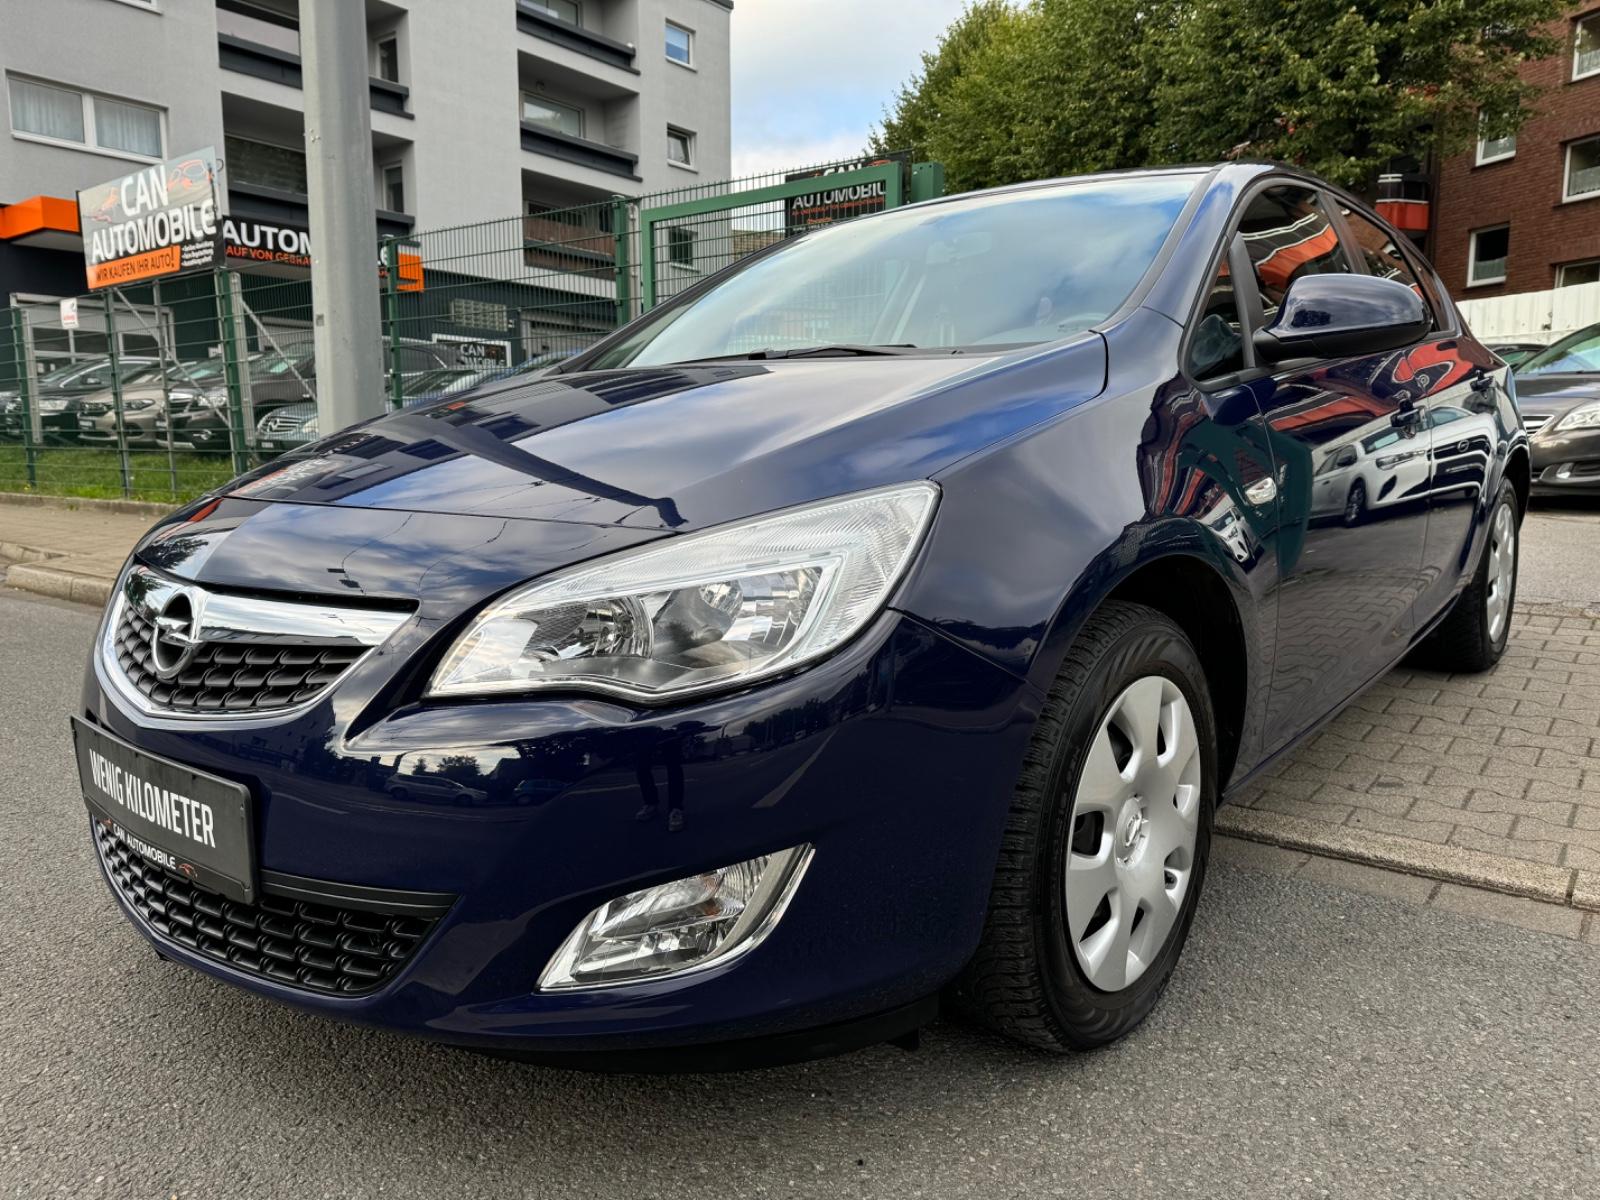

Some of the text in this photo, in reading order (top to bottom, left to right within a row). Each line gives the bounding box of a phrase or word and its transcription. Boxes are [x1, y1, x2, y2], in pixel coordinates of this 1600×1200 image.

[120, 164, 169, 218] CAN
[792, 181, 887, 210] AUTOMOBIL
[91, 198, 217, 264] AUTOMOBILE
[222, 219, 311, 255] AUTOM
[96, 268, 107, 282] WIR
[109, 262, 136, 278] KAUFEN
[137, 258, 150, 273] IHR
[151, 246, 175, 271] AUTO!
[225, 245, 248, 257] AUF
[250, 247, 273, 260] VON
[460, 343, 485, 357] CAN
[89, 748, 216, 848] WENIG KILOMETER
[113, 823, 176, 870] CAN AUTOMOBILE
